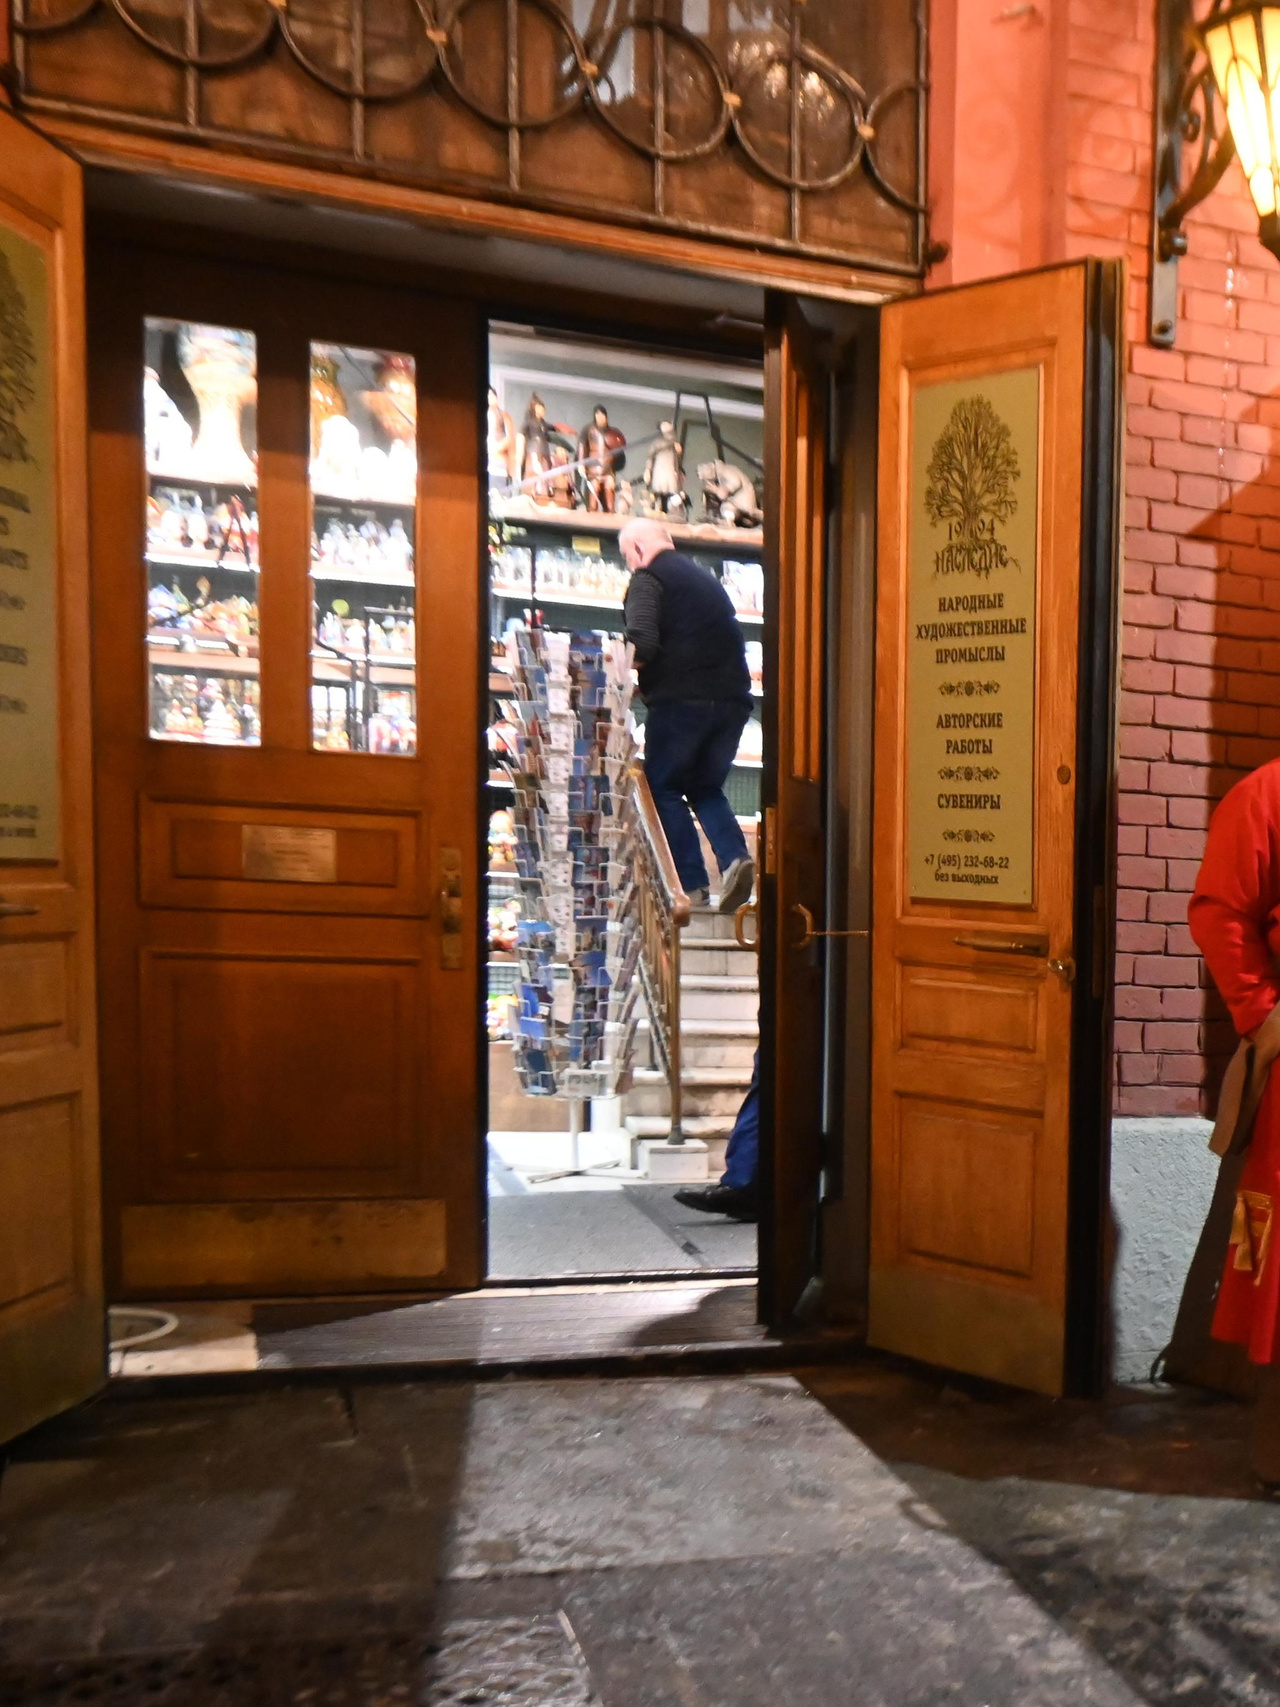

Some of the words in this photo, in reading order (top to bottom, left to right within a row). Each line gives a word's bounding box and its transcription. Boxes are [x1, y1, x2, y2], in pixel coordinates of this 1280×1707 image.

[935, 544, 1009, 575] НАСЛЕДИЕ
[938, 592, 1004, 613] НАРОДНЫЕ
[915, 618, 1027, 642] ХУДОЖЕСТВЕННЫЕ
[935, 645, 1006, 664] ПРОМЫСЛЫ
[936, 712, 1003, 729] АВТОРСКИЕ
[945, 739, 993, 754] РАБОТЫ
[937, 793, 1001, 810] СУВЕНИРЫ
[924, 854, 935, 865] +7
[937, 853, 961, 870] (495)
[964, 855, 1010, 869] 232-68-22
[934, 869, 949, 882] без
[951, 873, 999, 886] выходных
